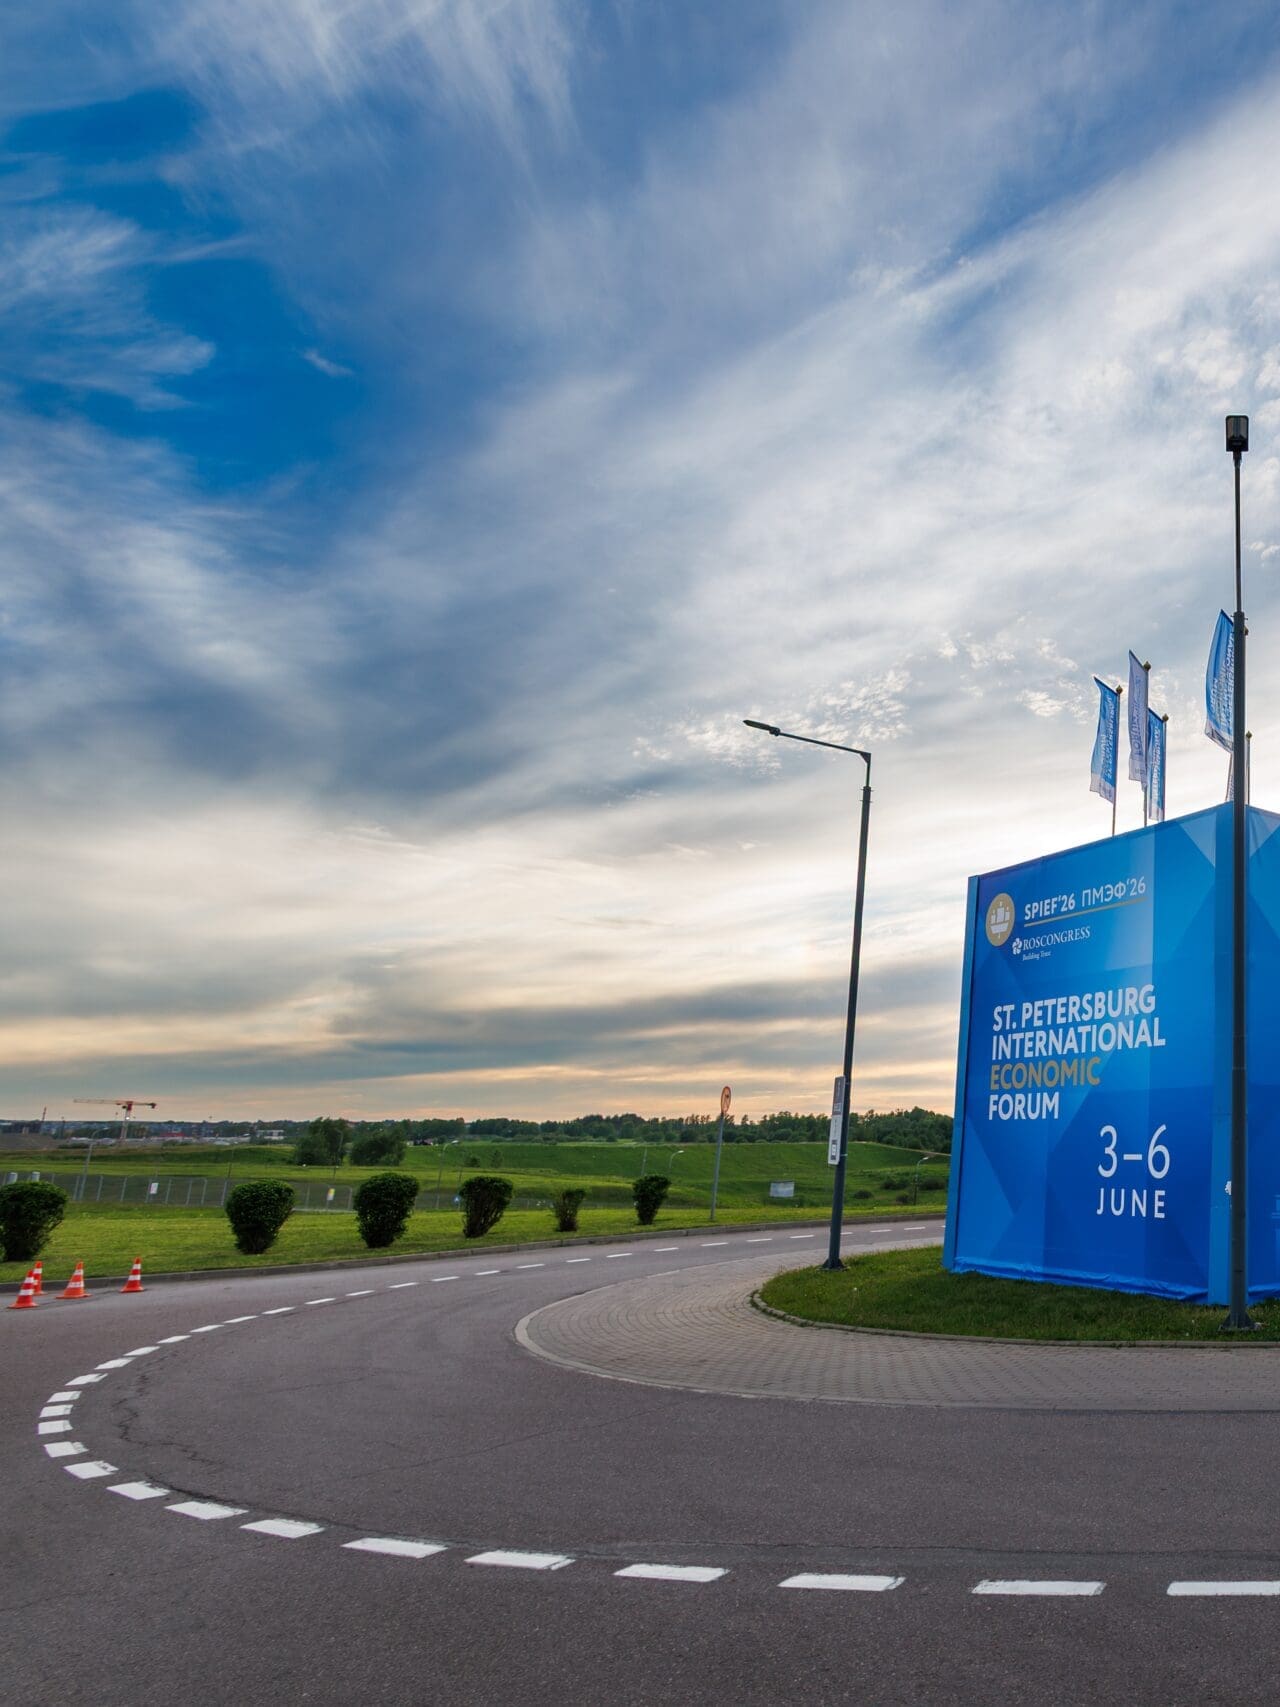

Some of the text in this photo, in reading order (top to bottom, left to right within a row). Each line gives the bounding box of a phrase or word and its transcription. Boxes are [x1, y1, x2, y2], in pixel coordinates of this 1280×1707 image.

[1022, 926, 1091, 951] ROSCONGRESS
[992, 984, 1156, 1032] ST. PETERSBURG
[991, 1017, 1167, 1061] INTERNATIONAL
[989, 1056, 1101, 1090] ECONOMIC
[988, 1091, 1060, 1121] FORUM
[1096, 1187, 1167, 1219] JUNE
